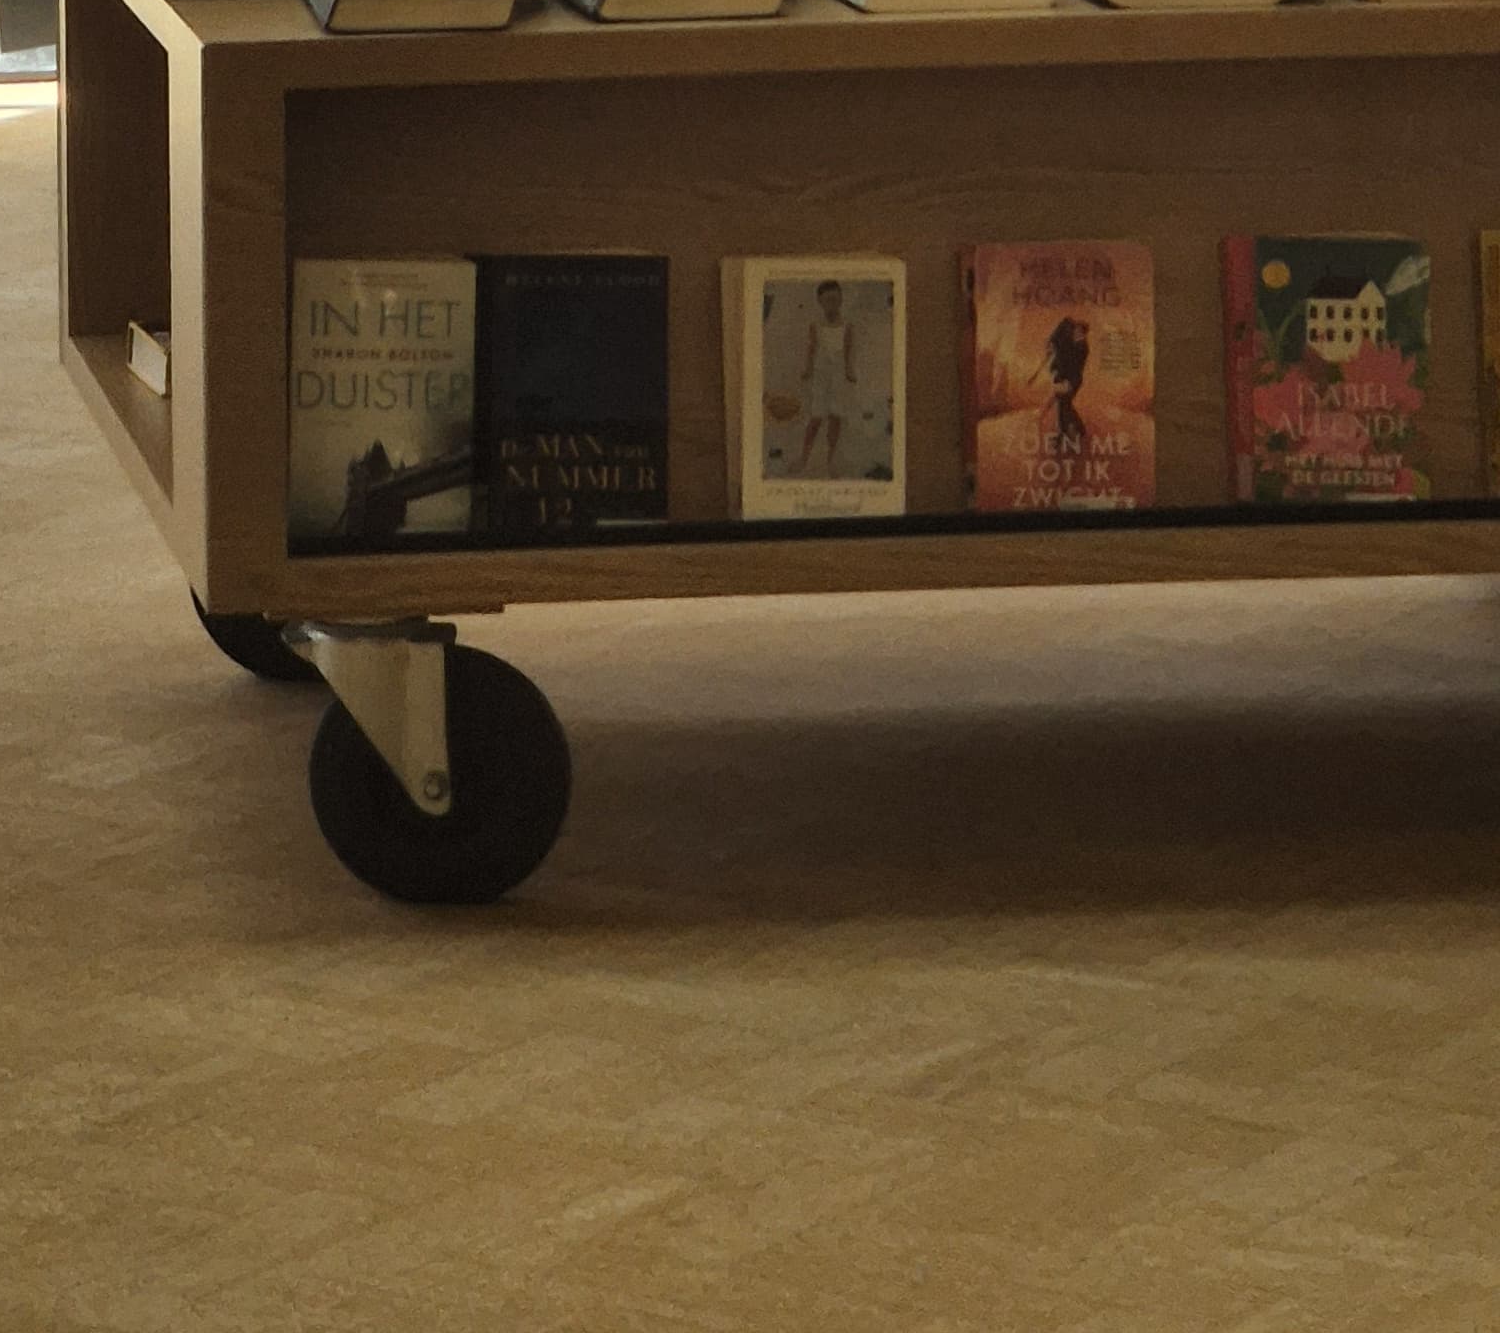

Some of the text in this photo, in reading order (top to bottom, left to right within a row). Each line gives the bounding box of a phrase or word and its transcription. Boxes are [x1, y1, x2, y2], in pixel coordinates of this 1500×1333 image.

[311, 299, 461, 338] IN HET
[1022, 459, 1111, 482] TOT IK
